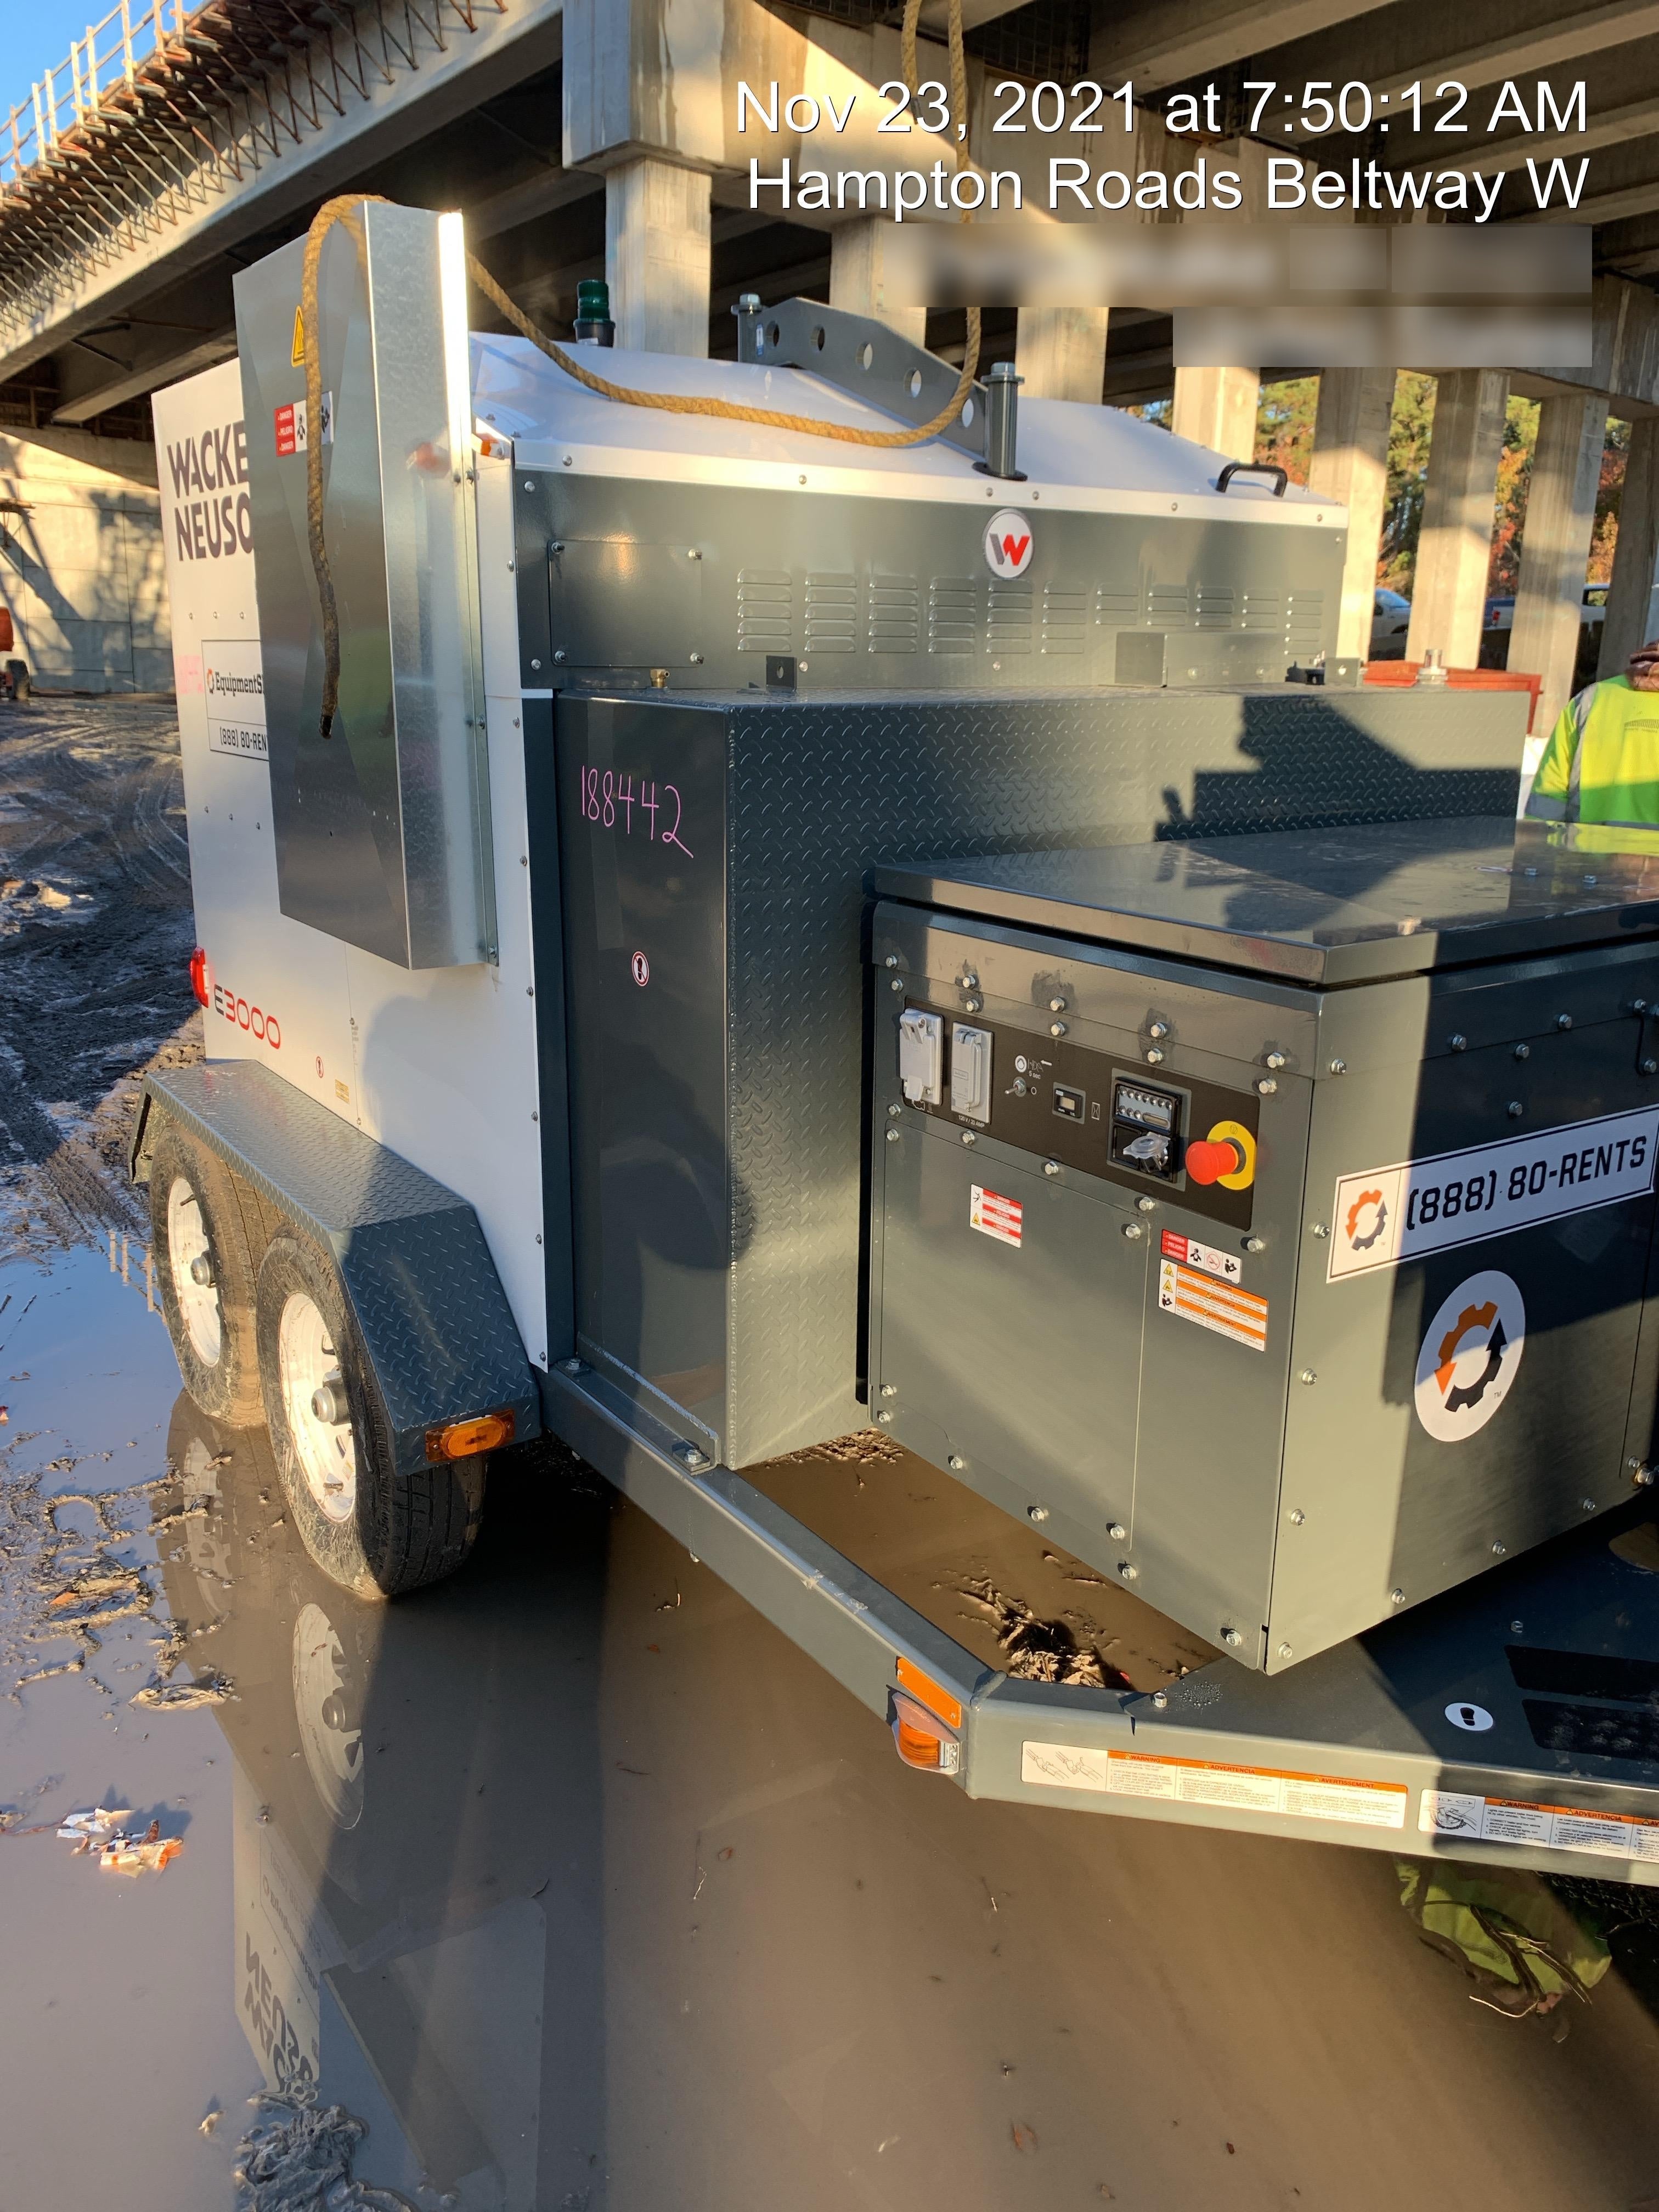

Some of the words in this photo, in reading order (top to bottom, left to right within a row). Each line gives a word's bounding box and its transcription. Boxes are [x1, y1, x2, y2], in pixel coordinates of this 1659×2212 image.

[167, 420, 249, 498] WACKE
[174, 492, 255, 561] NEUSO
[215, 672, 263, 697] EquipmentS
[219, 726, 239, 748] (888)
[582, 765, 694, 859] 188442
[214, 984, 281, 1049] E3000
[1406, 1170, 1497, 1231] (888)
[1508, 1135, 1647, 1201] 80-RENTS
[1131, 1755, 1161, 1763] WARNING
[1210, 1764, 1255, 1774] ADVERTENCIA
[1321, 1778, 1374, 1788] AVERTISSEMENT
[1507, 1801, 1539, 1810] WARNING
[1575, 1810, 1622, 1821] ADVERTENCIA
